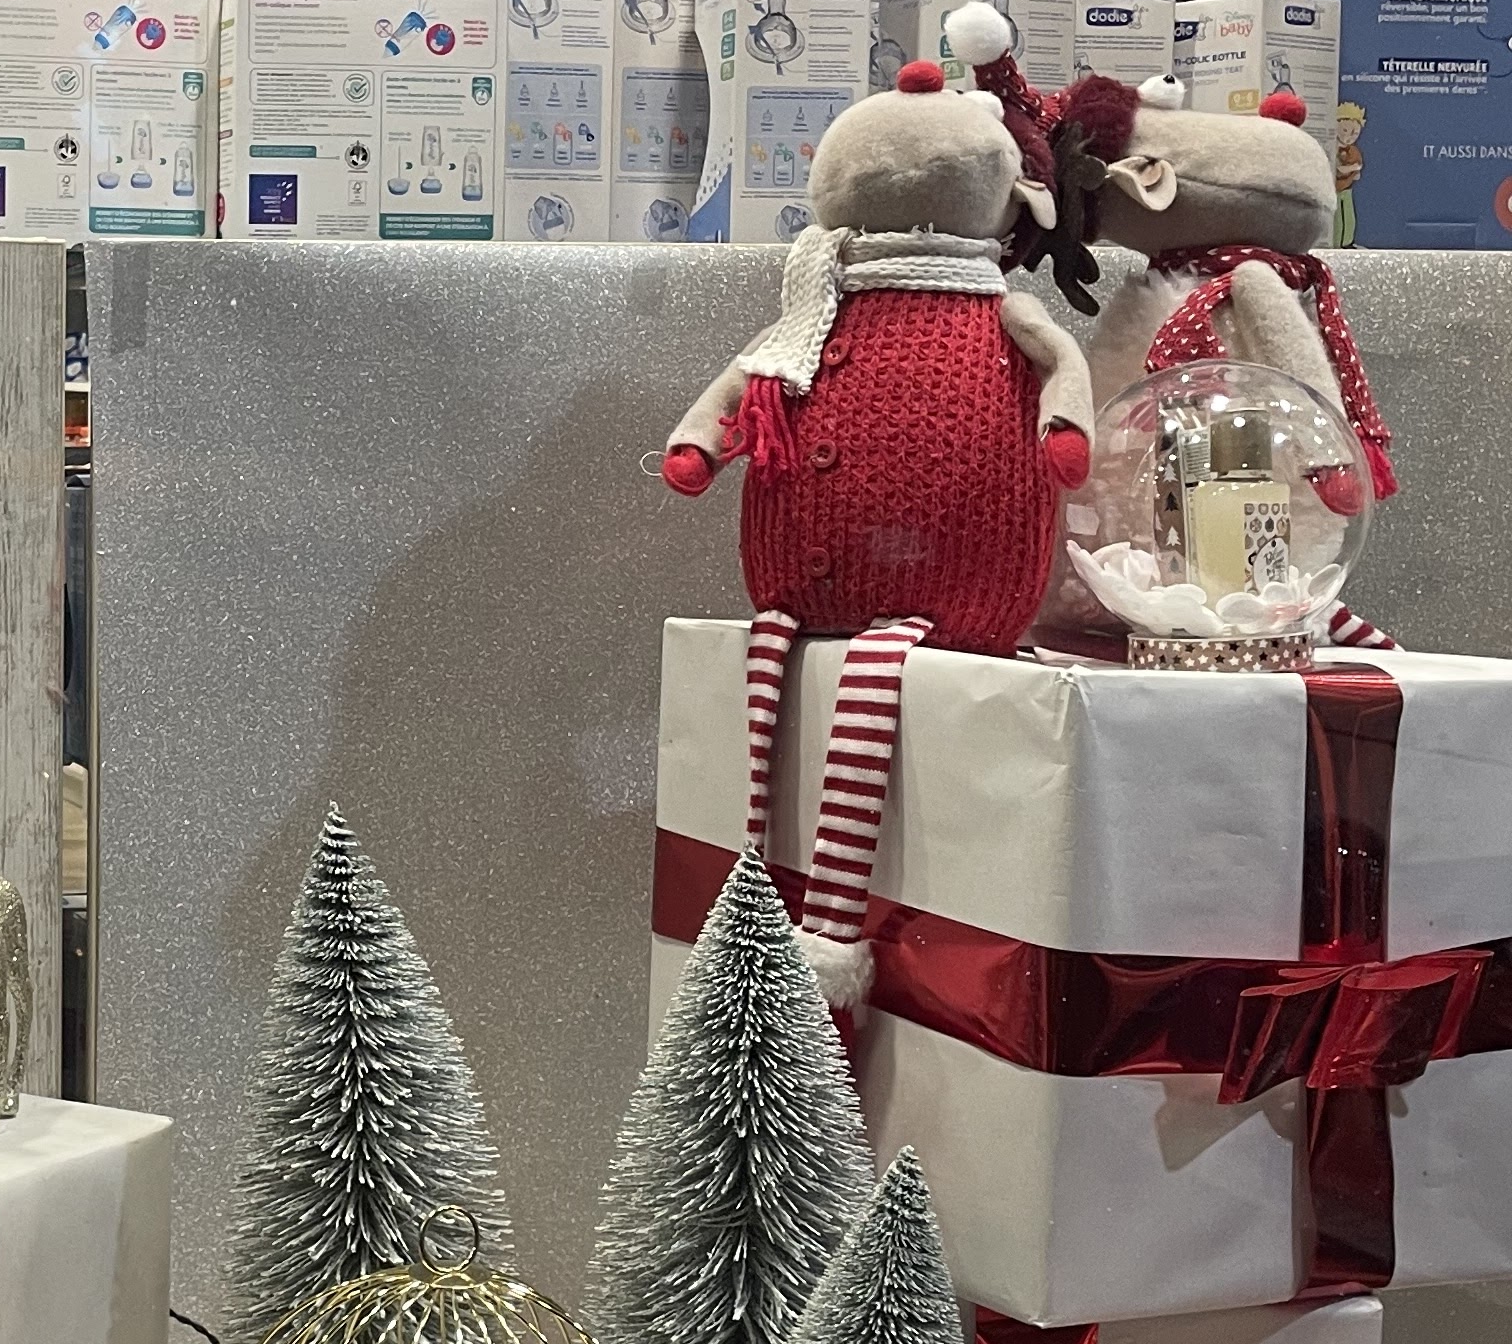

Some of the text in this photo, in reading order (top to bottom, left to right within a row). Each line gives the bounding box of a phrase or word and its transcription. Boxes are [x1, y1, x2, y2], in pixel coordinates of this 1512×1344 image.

[1088, 7, 1128, 23] dodie
[1286, 8, 1313, 24] dodie
[1470, 3, 1489, 14] bon
[1219, 21, 1255, 38] baby
[1213, 50, 1247, 63] BOTTLE
[1383, 58, 1488, 74] TÉTERELLE NERVURÉE
[1340, 74, 1354, 82] en
[1356, 71, 1392, 83] silicone
[1392, 73, 1408, 84] qui
[1384, 84, 1402, 94] des
[1423, 144, 1512, 161] ET AUSSI DANS
